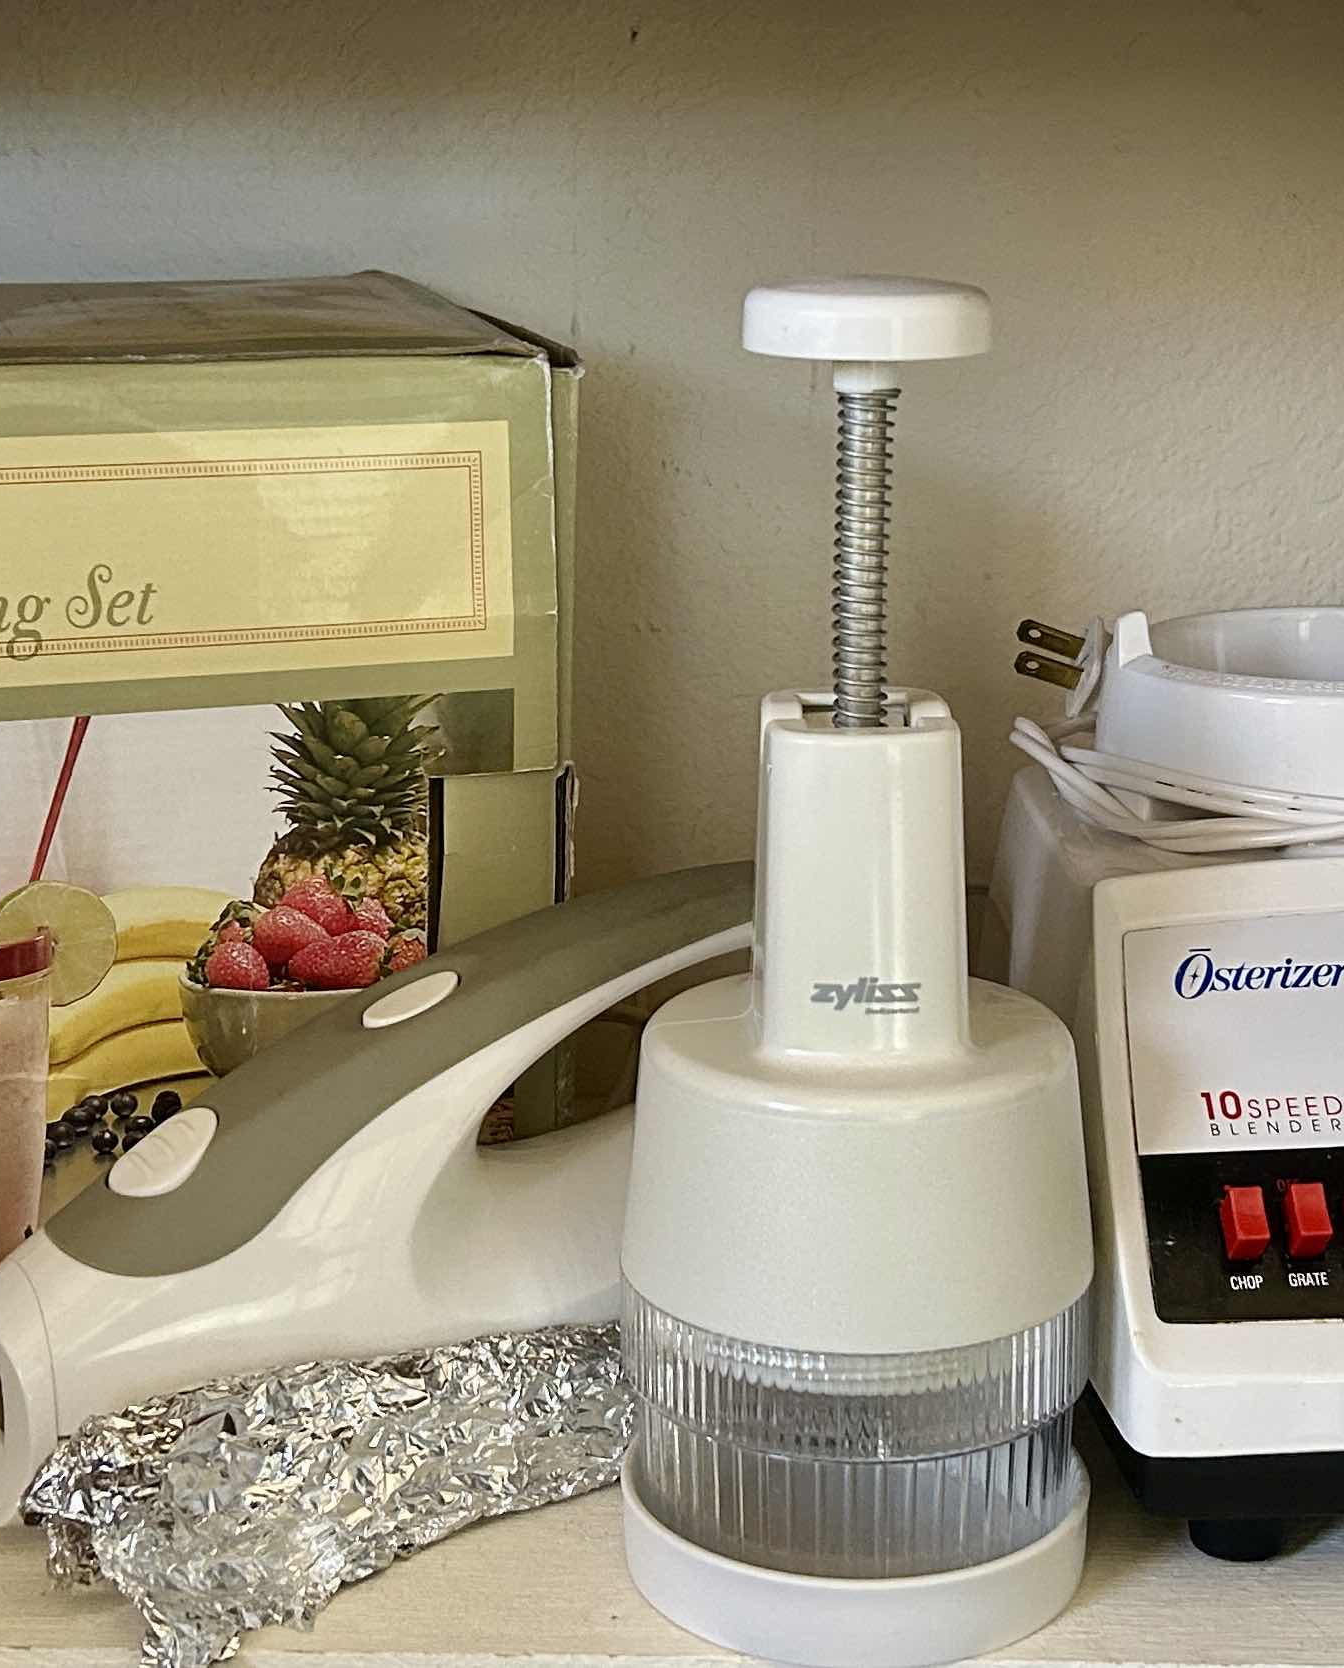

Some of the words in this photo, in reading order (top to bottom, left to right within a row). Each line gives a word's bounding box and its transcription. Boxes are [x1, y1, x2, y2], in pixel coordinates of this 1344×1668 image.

[65, 563, 158, 629] Set
[810, 976, 921, 1011] zyliss
[1201, 1091, 1242, 1121] 10
[1248, 1096, 1343, 1119] SPEED
[1210, 1118, 1342, 1137] BLENDER
[1229, 1275, 1264, 1291] CHOP
[1288, 1271, 1330, 1287] GRATE
